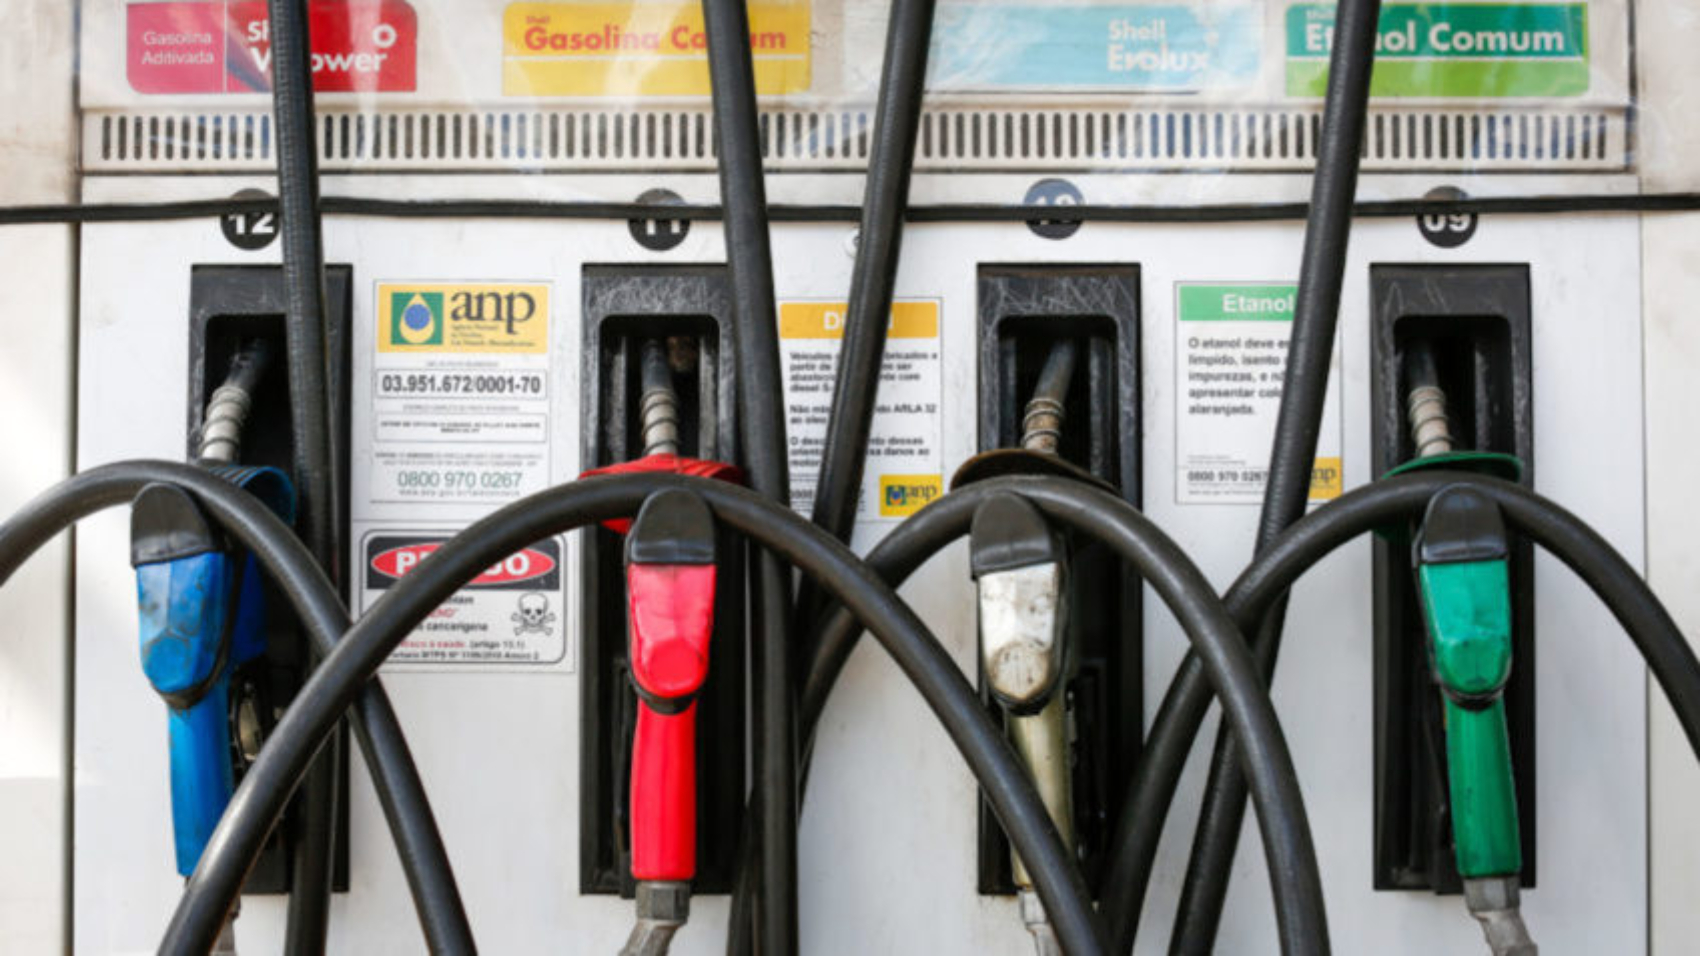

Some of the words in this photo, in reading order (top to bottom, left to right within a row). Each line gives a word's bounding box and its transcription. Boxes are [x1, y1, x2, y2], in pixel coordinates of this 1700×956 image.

[143, 32, 212, 46] Gasolina
[524, 25, 659, 51] Gasolina
[671, 26, 786, 50] Com
[1108, 20, 1166, 41] Shell
[1305, 21, 1416, 51] Etol
[1429, 24, 1564, 51] Comum
[141, 51, 214, 65] Aditivada
[1107, 46, 1210, 72] Evolux
[450, 290, 536, 335] anp
[1222, 293, 1295, 314] Etanol
[1188, 337, 1200, 349] O
[1202, 338, 1241, 349] etanol
[1244, 338, 1275, 349] deve
[1242, 354, 1280, 365] isento
[1188, 387, 1255, 400] apresentar
[397, 470, 441, 488] 0800
[444, 471, 477, 489] 970
[480, 471, 523, 489] 0267
